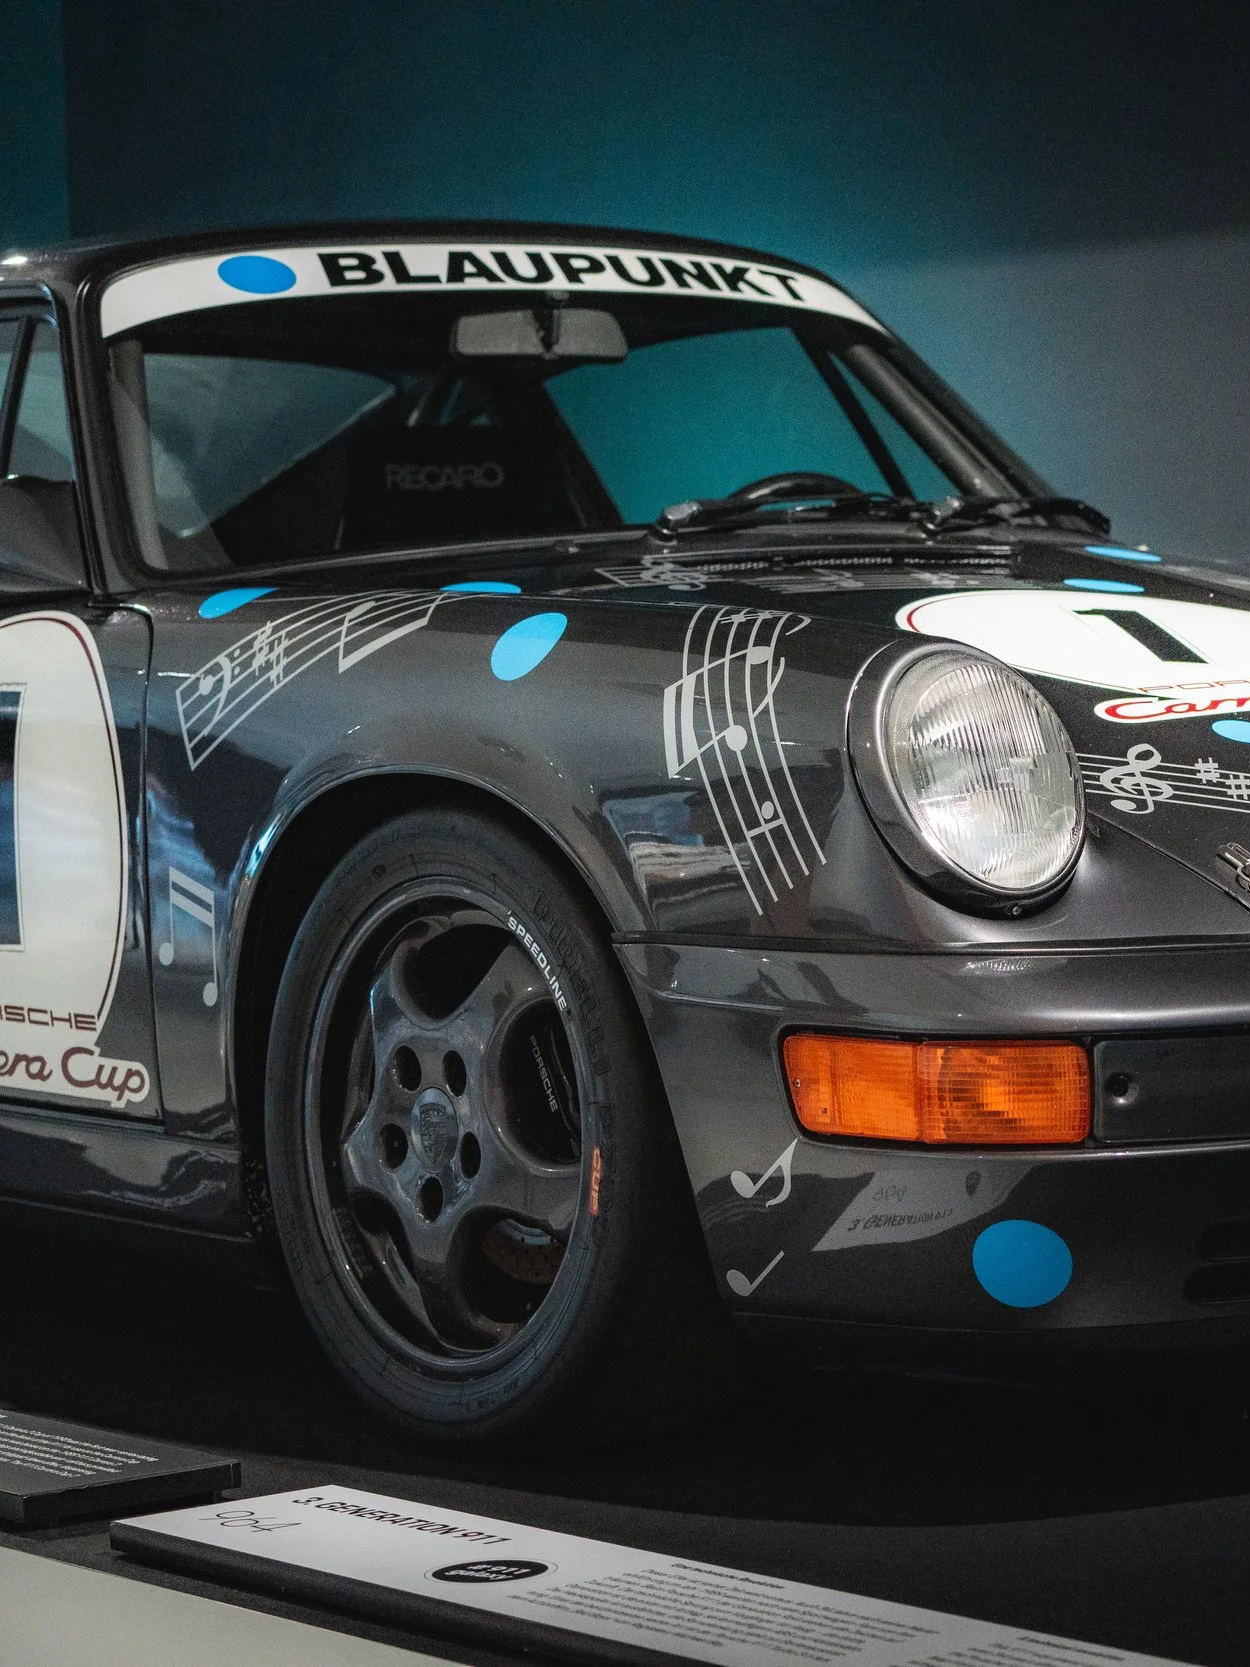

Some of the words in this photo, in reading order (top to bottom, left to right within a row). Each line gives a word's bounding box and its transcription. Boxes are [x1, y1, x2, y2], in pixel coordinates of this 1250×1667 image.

[319, 250, 807, 302] BLAUPUNKT
[385, 460, 505, 490] RECARO
[1073, 608, 1209, 664] 1
[507, 916, 568, 1012] SPEEDLINE
[0, 1004, 97, 1031] SCHE
[62, 1046, 145, 1100] Cup
[528, 1034, 559, 1113] PORSCHE
[199, 1509, 302, 1535] 964
[292, 1496, 323, 1506] 3.
[314, 1501, 466, 1538] GENERATION
[454, 1529, 512, 1546] 911
